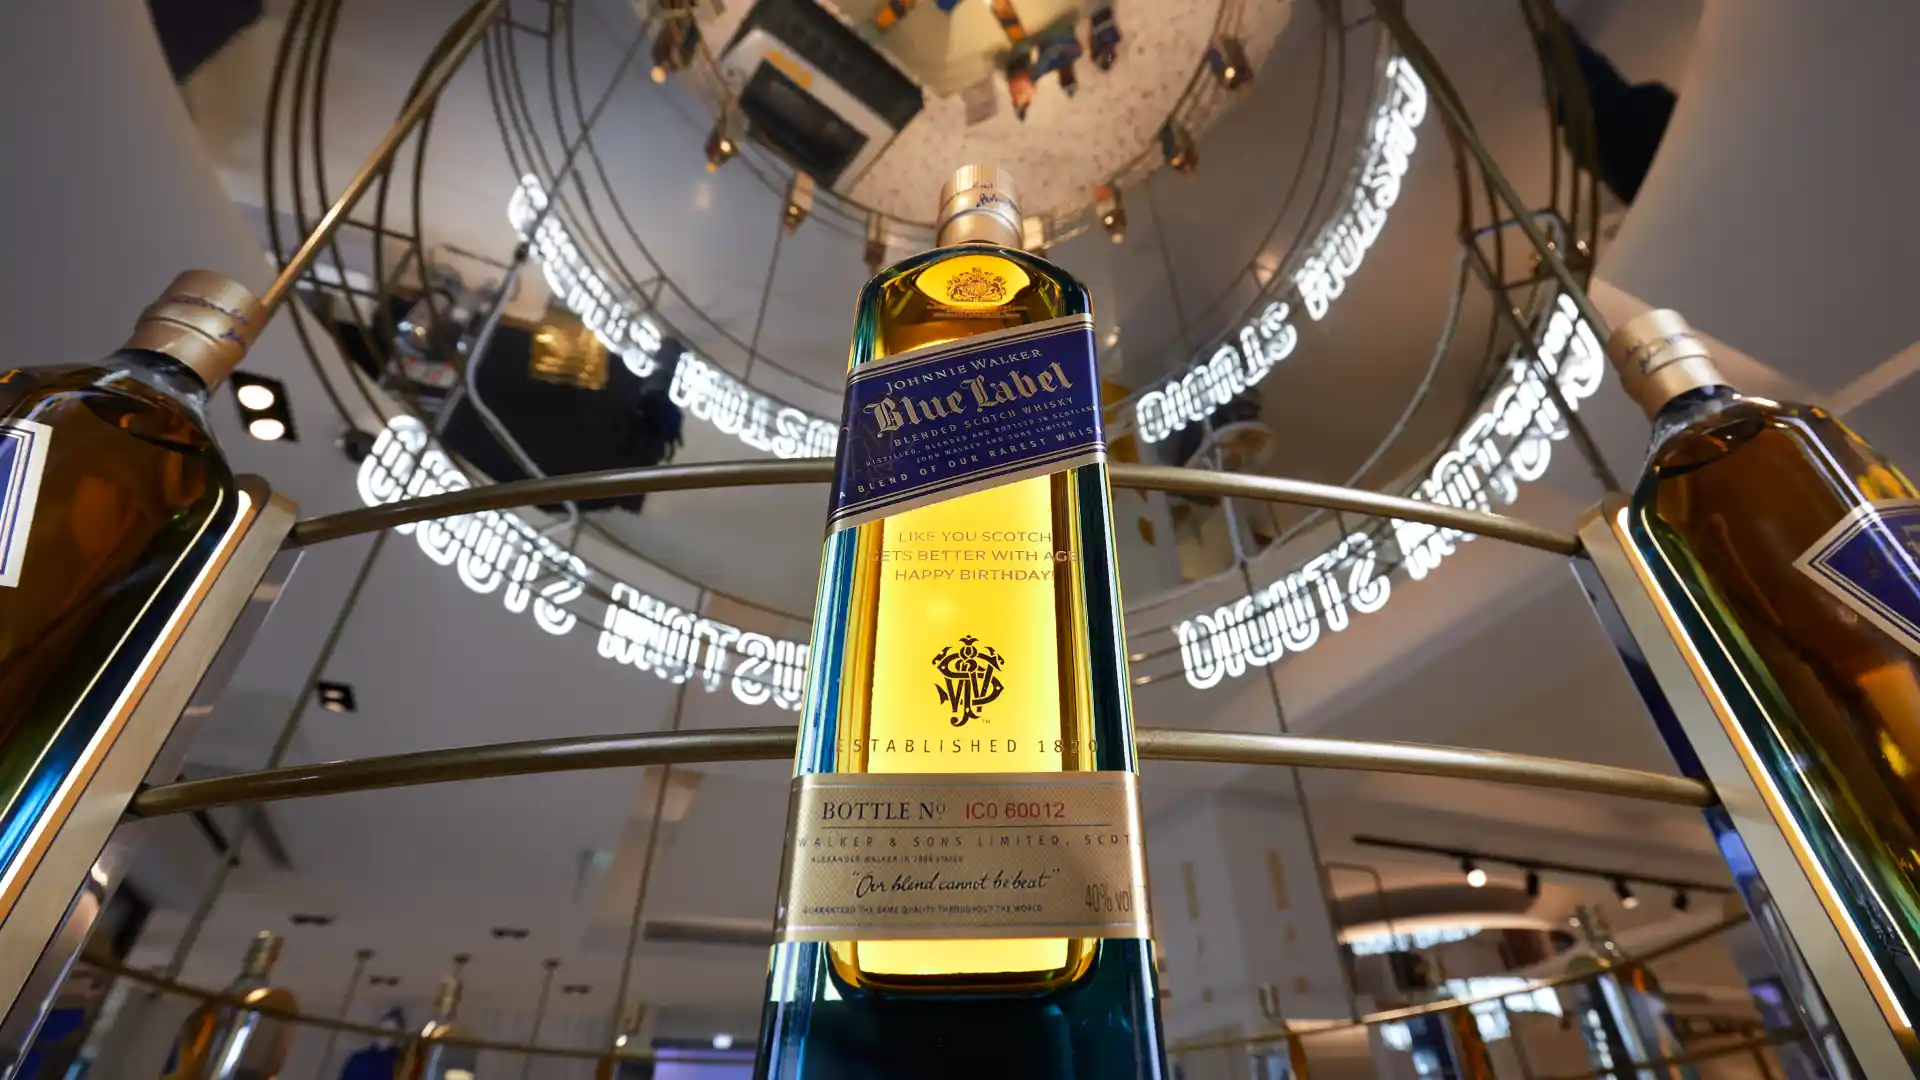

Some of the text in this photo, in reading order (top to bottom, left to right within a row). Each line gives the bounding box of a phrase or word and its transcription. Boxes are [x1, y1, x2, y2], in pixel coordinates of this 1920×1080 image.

[886, 349, 1042, 395] JOHNNIE WALKER
[1136, 301, 1297, 443] STUDIO
[669, 351, 836, 458] USTOM
[863, 361, 1073, 438] Blue Label
[894, 396, 1074, 447] BLENDED SCOTCH WHISKY
[916, 420, 1073, 464] JOHN WALKER AND SONS LIMITED
[925, 436, 967, 451] BLENDED
[972, 429, 990, 439] AND
[994, 419, 1034, 433] BOTTLED
[839, 491, 846, 500] A
[857, 472, 908, 494] BLEND
[919, 464, 937, 477] OF
[948, 453, 979, 469] OUR
[988, 438, 1047, 458] RAREST
[899, 531, 1052, 543] LIKE YOU SCOTCH
[917, 549, 986, 562] BETTER
[991, 549, 1038, 562] WITH
[1043, 549, 1079, 562] AGE
[895, 569, 1056, 581] HAPPY BIRTHDAY!
[837, 738, 1099, 753] ESTABLISHED 1820
[822, 801, 909, 821] BOTTLE
[1004, 801, 1066, 819] 60012
[799, 836, 874, 848] WALKER
[889, 837, 897, 847] &
[913, 835, 964, 848] SONS
[978, 834, 1070, 849] LIMITED,
[811, 855, 860, 863] ALEXANDER
[863, 855, 898, 863] WALKER
[891, 872, 940, 893] blend
[938, 870, 986, 891] cannot
[993, 869, 1011, 890] be
[803, 904, 1043, 915] GUARANTEED THE SAME QUALITY THROUGHOUT THE WORLD
[1085, 883, 1113, 913] 40%
